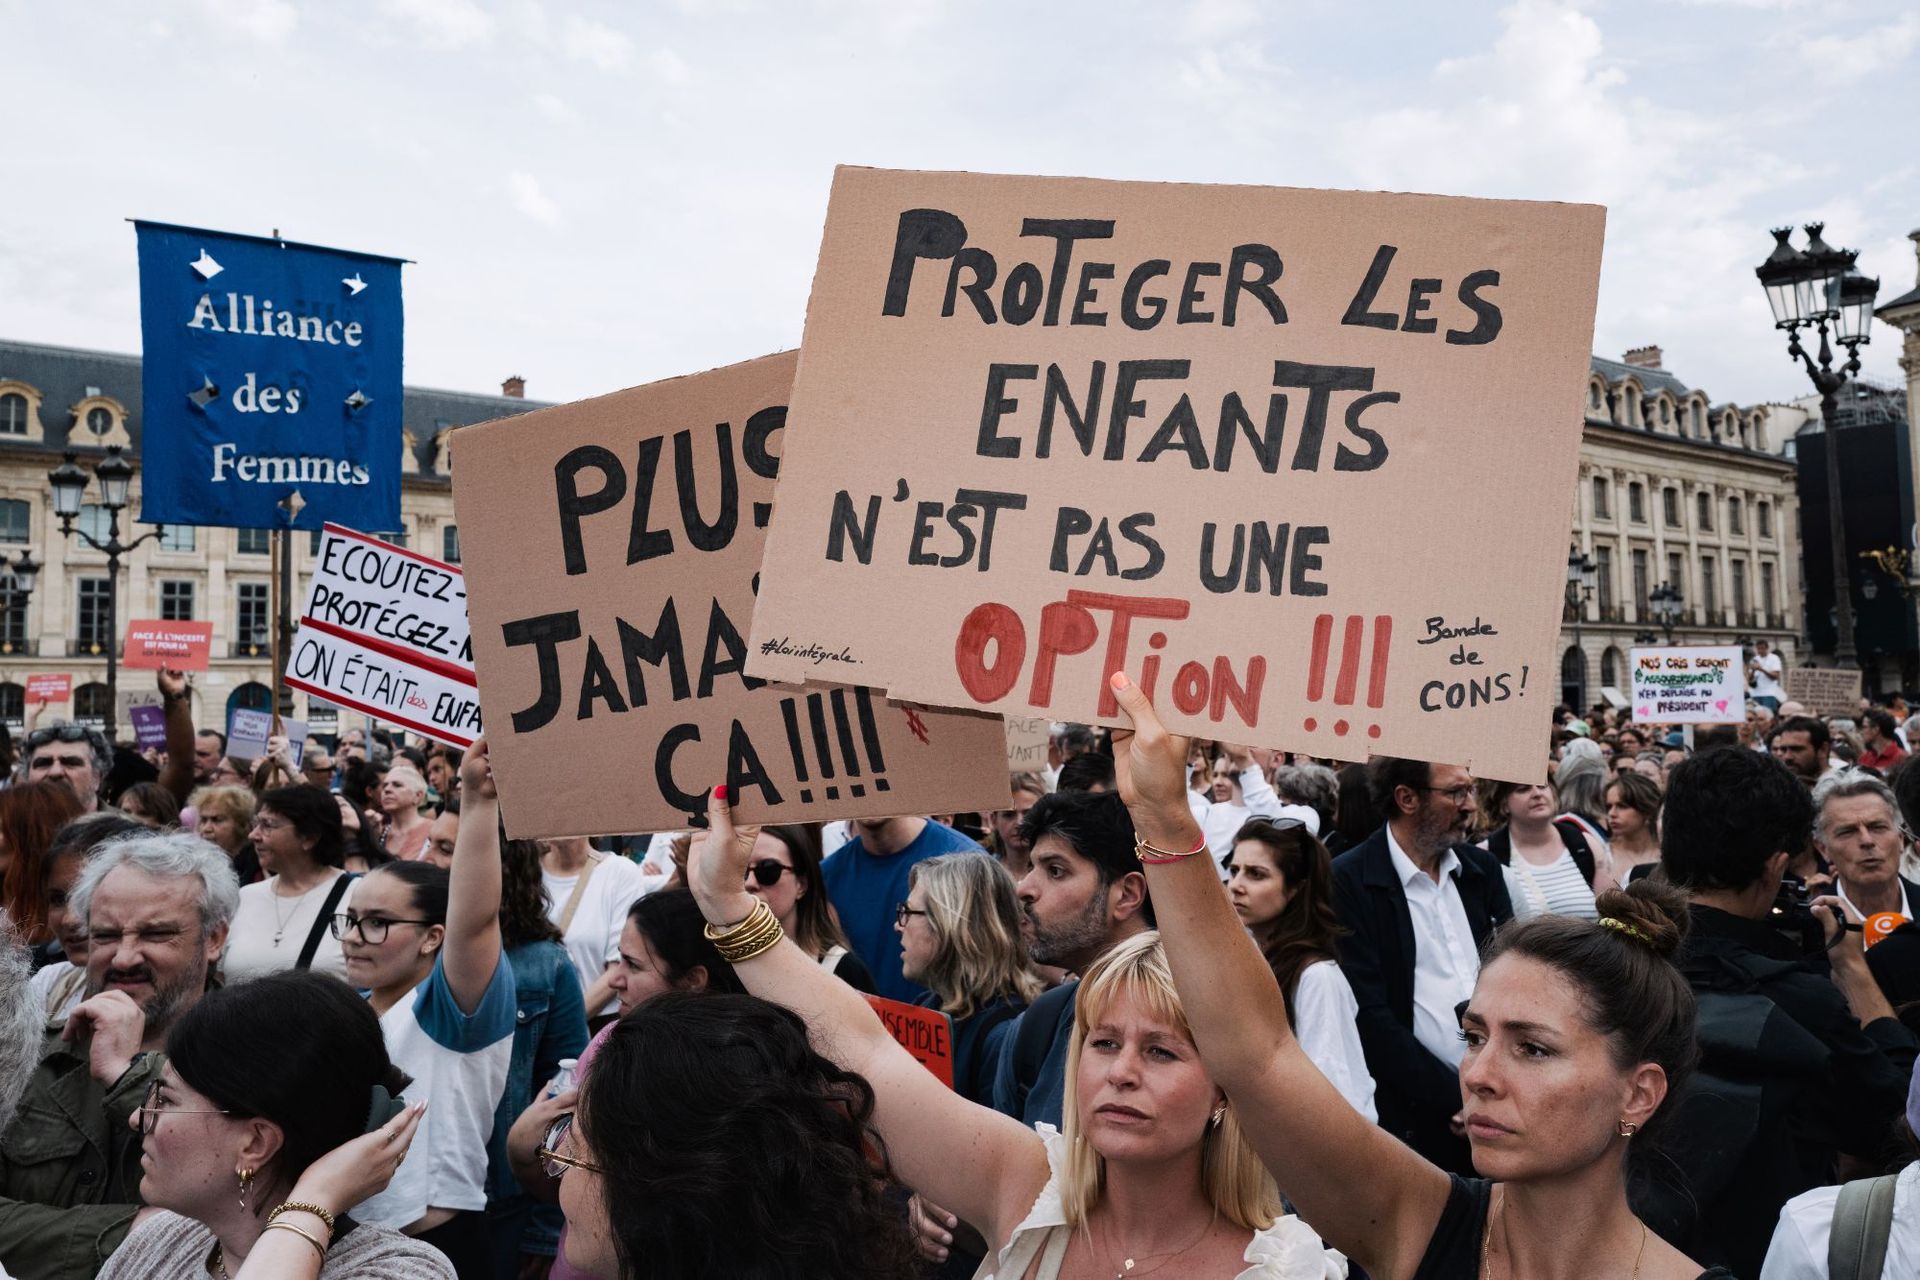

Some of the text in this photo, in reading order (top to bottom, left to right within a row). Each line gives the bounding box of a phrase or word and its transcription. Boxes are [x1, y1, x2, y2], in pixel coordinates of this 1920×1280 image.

[882, 208, 1502, 345] PROTEGER LES
[187, 293, 362, 347] Alliance
[232, 373, 300, 414] des
[976, 360, 1400, 474] ENFANTS
[211, 443, 369, 485] Femmes
[826, 478, 1330, 596] N'EST PAS UNE
[322, 537, 466, 602] ECOUTEZ-
[1417, 616, 1498, 644] Bande
[1450, 644, 1484, 665] de
[295, 639, 336, 687] ON
[502, 594, 779, 734] JAMA
[1307, 614, 1392, 739] !!!
